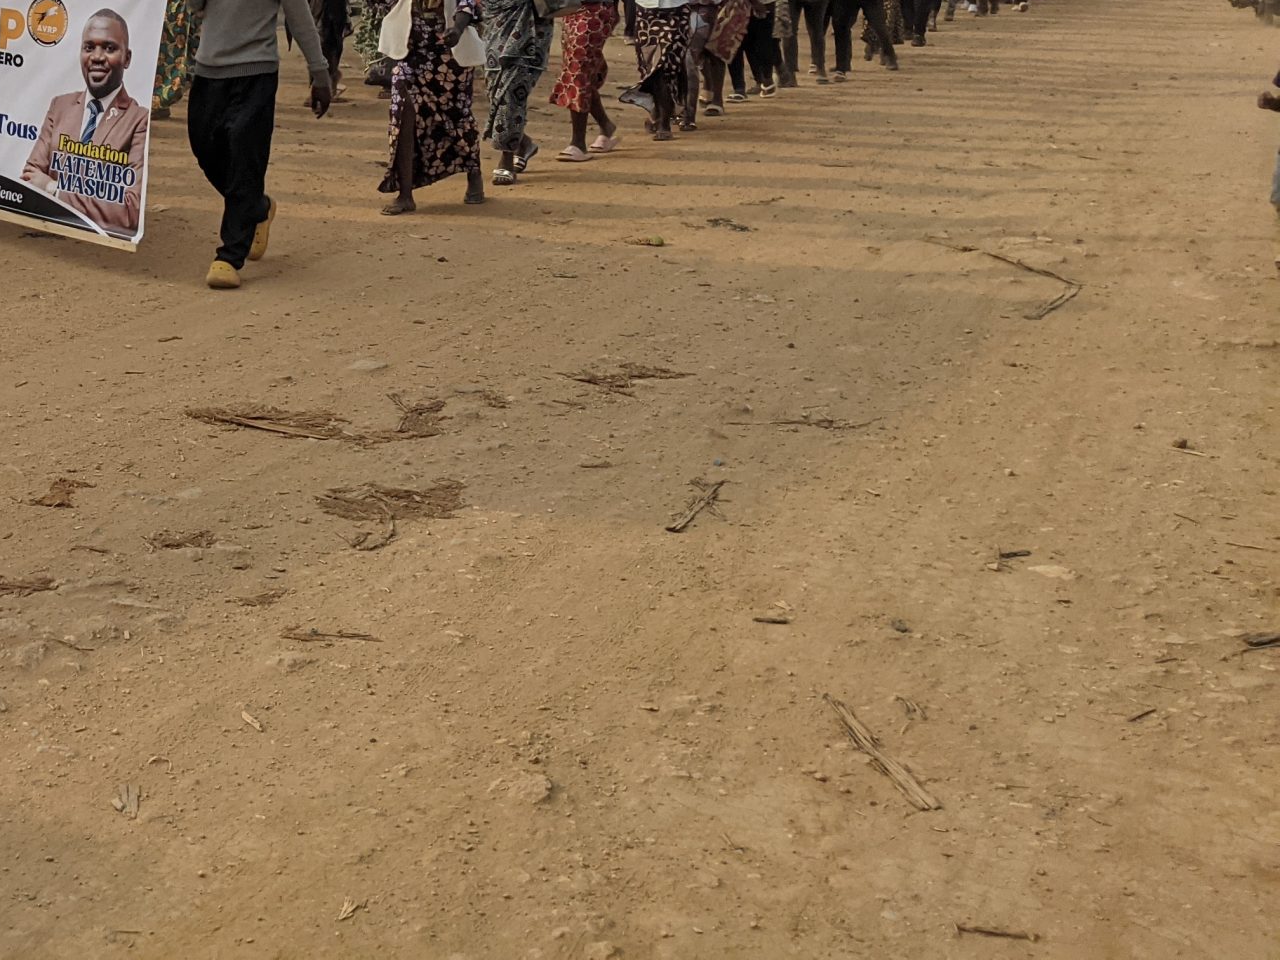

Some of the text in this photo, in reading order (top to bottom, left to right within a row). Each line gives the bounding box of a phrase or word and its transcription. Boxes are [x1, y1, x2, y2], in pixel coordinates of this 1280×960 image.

[37, 24, 58, 34] AVRP
[58, 134, 129, 166] Fondation
[51, 151, 136, 187] KATEMBO
[56, 171, 126, 204] MASUDI
